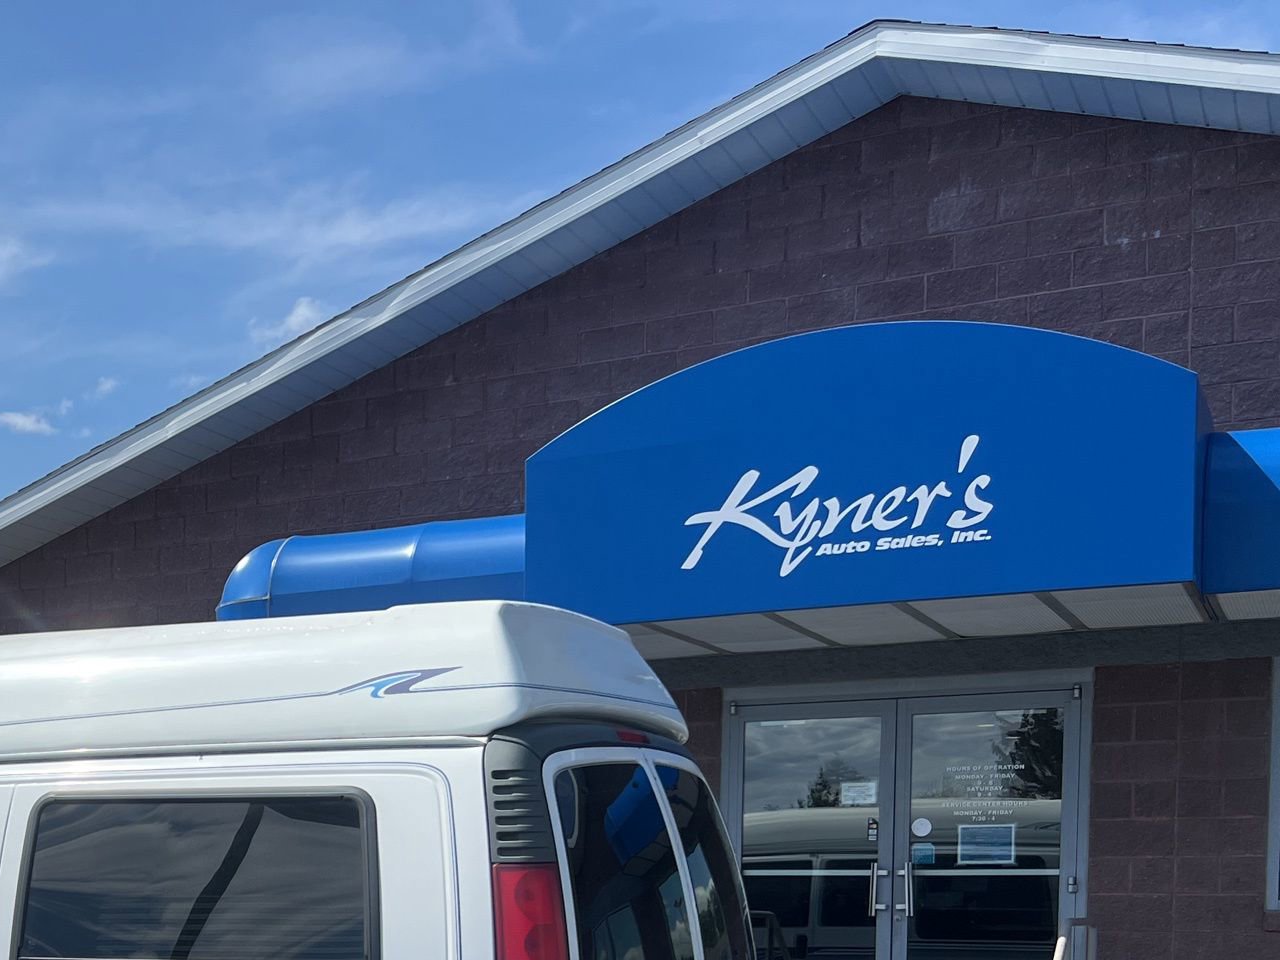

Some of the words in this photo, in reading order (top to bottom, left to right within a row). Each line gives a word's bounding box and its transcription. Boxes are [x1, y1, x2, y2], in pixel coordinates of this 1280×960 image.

[681, 434, 994, 577] Kyner's
[815, 540, 870, 556] Auto
[875, 534, 943, 550] Sales,
[951, 529, 992, 543] Inc.
